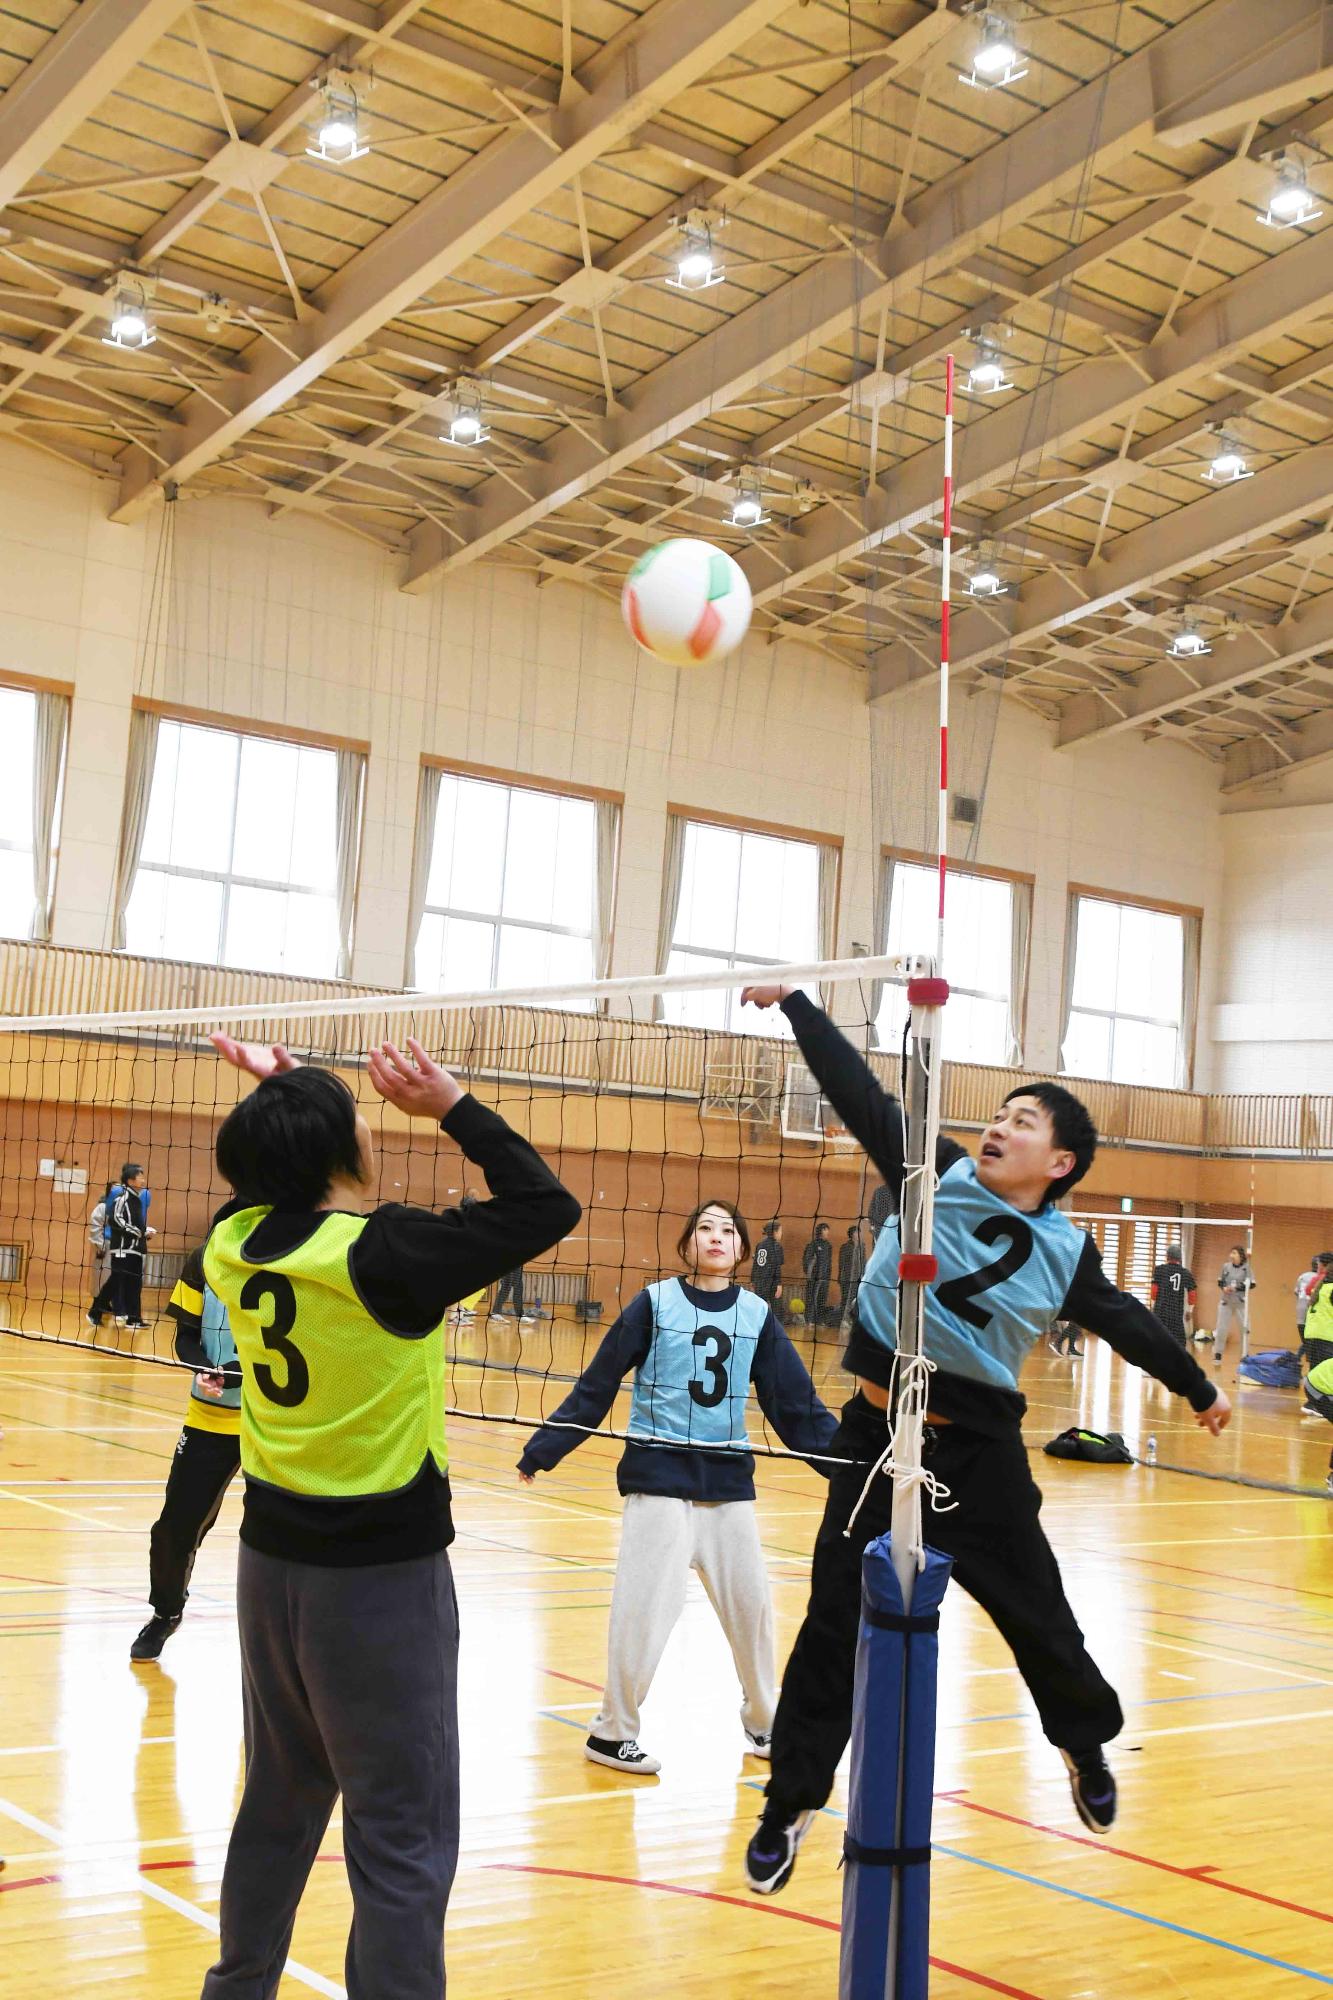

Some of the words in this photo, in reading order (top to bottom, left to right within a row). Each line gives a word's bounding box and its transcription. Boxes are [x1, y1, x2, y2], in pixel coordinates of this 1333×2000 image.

[757, 1248, 768, 1267] 8
[934, 1214, 1034, 1330] 2
[1169, 1272, 1181, 1291] 1
[240, 1270, 310, 1408] 3
[688, 1325, 732, 1408] 3
